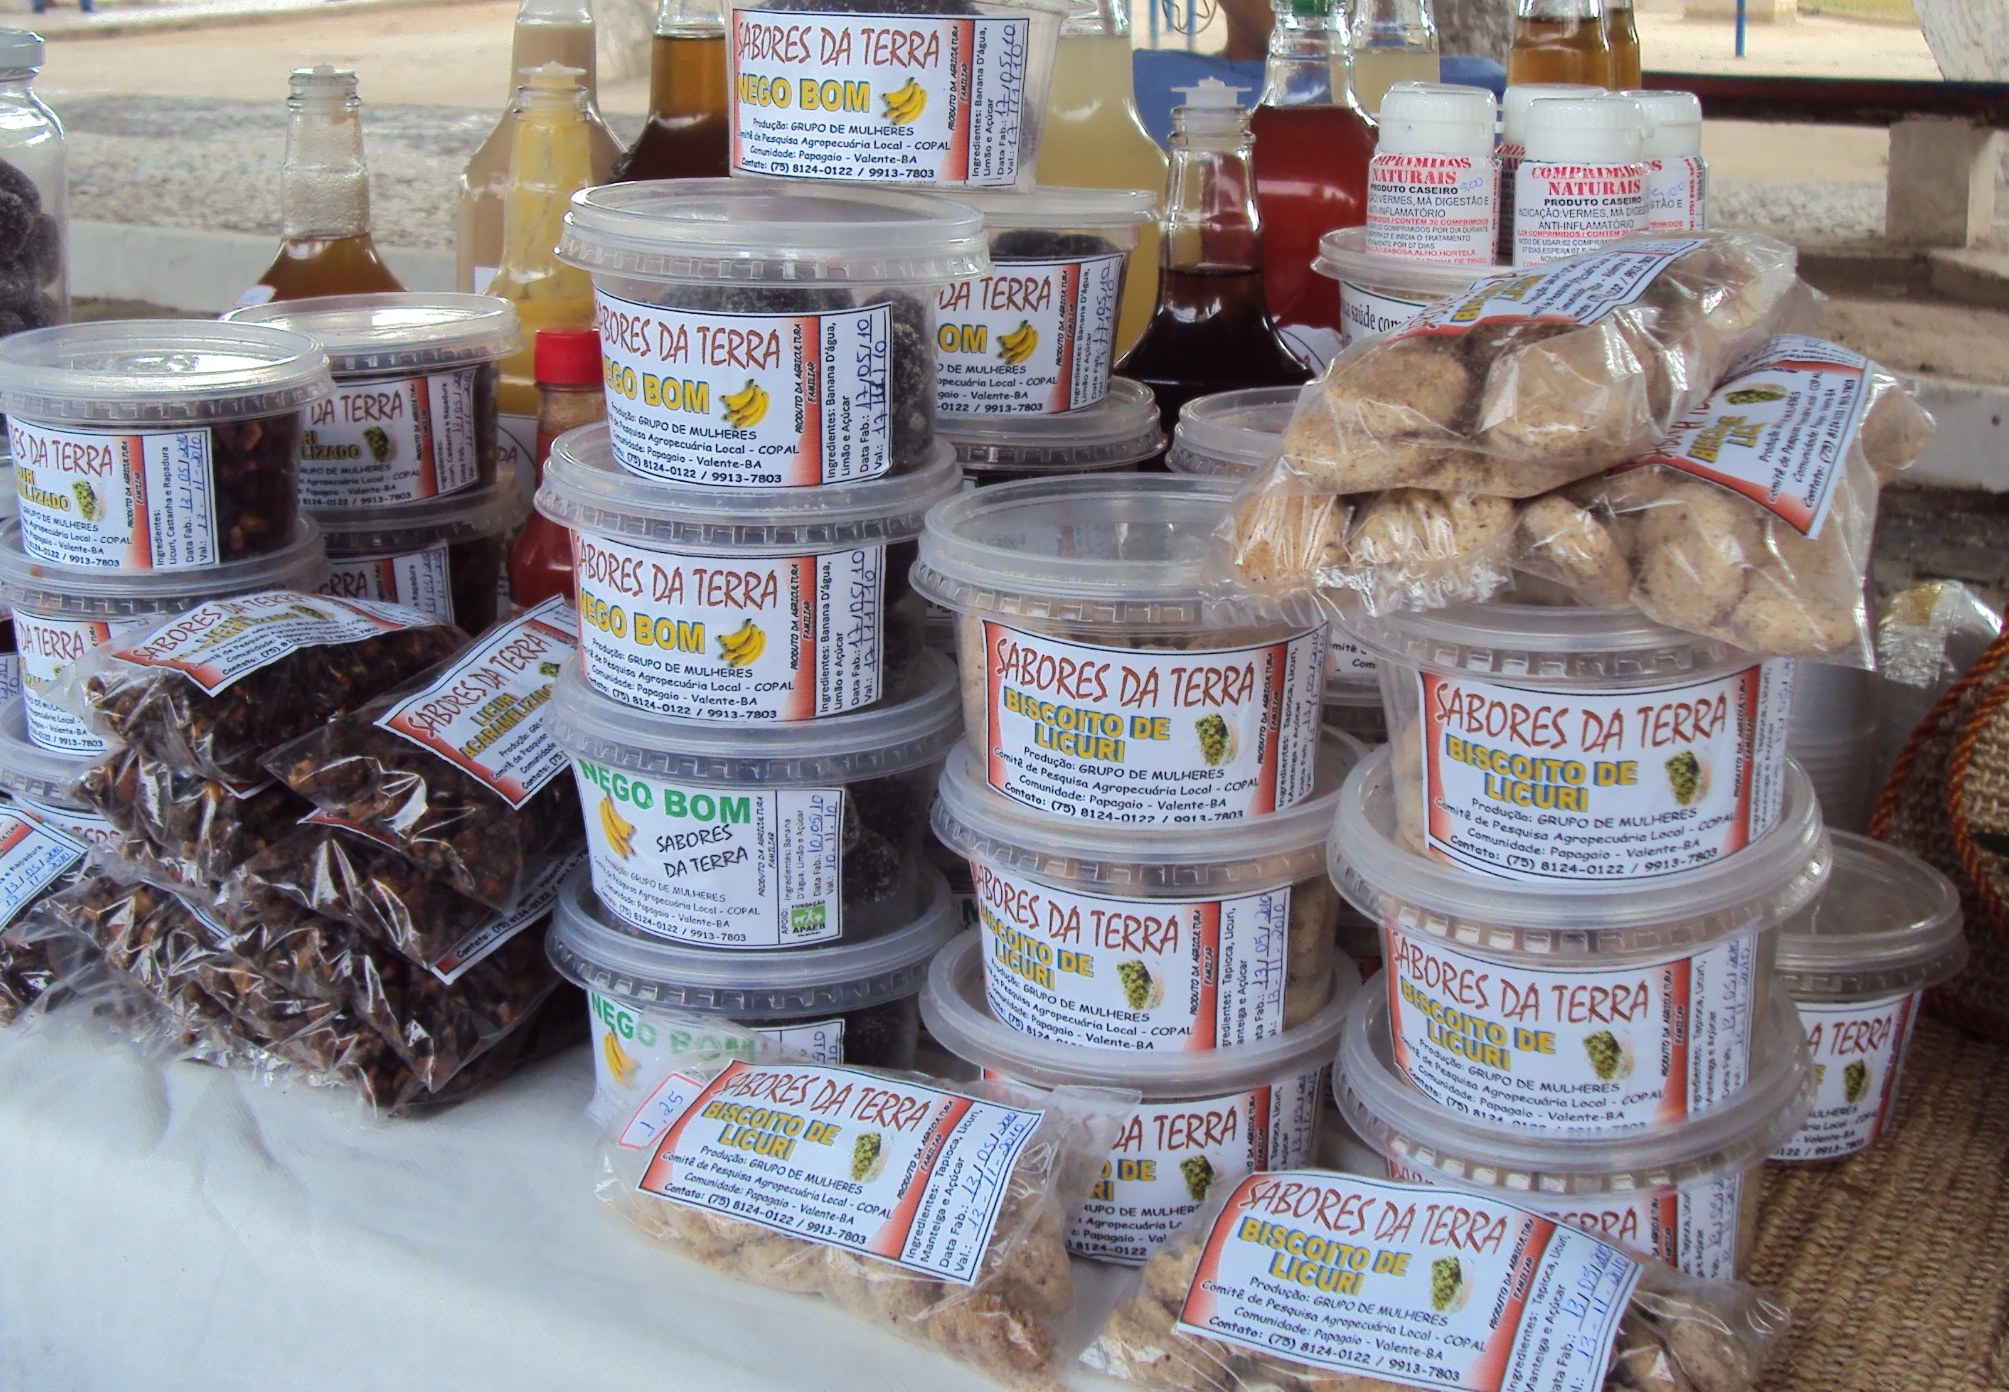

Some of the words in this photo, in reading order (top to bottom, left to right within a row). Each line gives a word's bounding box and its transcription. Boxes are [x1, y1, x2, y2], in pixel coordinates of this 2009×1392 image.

[738, 22, 812, 63] SABORES
[820, 27, 851, 66] DA
[861, 28, 940, 69] TERRA
[738, 72, 792, 108] NEGO
[799, 78, 870, 112] BOM
[975, 66, 984, 109] Banana
[752, 118, 788, 132] Produção:
[791, 122, 827, 134] GRUPO
[830, 124, 844, 134] DE
[848, 126, 914, 136] MULHERES
[972, 110, 982, 178] Ingredientes:
[1371, 184, 1405, 192] PRODUTO
[1372, 168, 1456, 184] NATURAIS
[1548, 180, 1640, 196] NATURAIS
[1544, 198, 1598, 206] PRODUTO
[1602, 197, 1641, 205] CASEIRO
[1539, 220, 1634, 230] ANTI-INFLAMATÓRIO
[980, 276, 1051, 312] TERRA
[598, 302, 650, 356] BORES
[658, 321, 688, 364] DA
[697, 326, 780, 370] TERRA
[1351, 303, 1375, 330] saúde
[795, 380, 802, 391] DA
[826, 368, 834, 410] Banana
[947, 365, 962, 373] DE
[965, 366, 1026, 374] MULHERES
[344, 390, 403, 422] TERRA
[643, 372, 709, 414] BOM
[794, 392, 804, 434] PRODUTO
[842, 396, 850, 433] Açúcar
[860, 416, 868, 444] Fab.:
[30, 435, 48, 468] DA
[52, 440, 113, 477] TERRA
[826, 412, 836, 479] Ingredientes:
[841, 445, 850, 476] Limão
[860, 450, 869, 472] Data
[163, 447, 171, 491] Rapadura
[167, 500, 175, 536] Castanha
[360, 492, 411, 504] 9913-7803
[152, 510, 164, 565] Ingredientes:
[169, 539, 177, 565] Licuri,
[580, 540, 643, 597] ABORES
[653, 563, 682, 604] DA
[693, 568, 777, 610] TERRA
[20, 622, 34, 652] DA
[34, 626, 84, 660] TERRA
[133, 609, 222, 661] SABORES
[221, 601, 244, 615] DA
[634, 612, 704, 654] BOM
[407, 680, 487, 738] SABORES
[468, 668, 510, 689] DA
[489, 632, 552, 674] TERRA
[996, 638, 1111, 703] SABORES
[1120, 666, 1158, 708] DA
[1170, 661, 1255, 707] TERRA
[470, 692, 520, 727] LICURI
[1003, 685, 1124, 739] BISCOITO
[1131, 715, 1170, 741] DE
[1436, 683, 1569, 750] SABORES
[1581, 708, 1623, 753] DA
[1637, 692, 1726, 750] TERRA
[1023, 746, 1076, 771] Produção:
[1078, 763, 1124, 779] GRUPO
[1129, 768, 1146, 779] DE
[1152, 770, 1225, 780] MULHERES
[1035, 722, 1125, 763] LICURI
[1446, 734, 1586, 786] BISCOITO
[1593, 761, 1638, 786] DE
[578, 759, 654, 810] NEGO
[664, 789, 751, 824] BOM
[994, 746, 1023, 767] Comitê
[1026, 763, 1038, 773] de
[1040, 766, 1089, 790] Pesquisa
[1092, 775, 1177, 797] Agropecuária
[1181, 784, 1212, 796] Local
[1224, 777, 1259, 791] COPAL
[1004, 782, 1046, 807] Contato:
[1051, 801, 1076, 816] (75)
[1080, 805, 1155, 822] 8124-0122
[1019, 775, 1085, 803] Comunidade:
[1089, 794, 1143, 810] Papagaio
[1157, 798, 1226, 810] Valente-BA
[1485, 773, 1589, 813] LICURI
[10, 845, 43, 871] Rapadura
[656, 824, 733, 853] SABORES
[1450, 836, 1501, 861] Contato:
[1506, 855, 1535, 870] (75)
[1541, 861, 1624, 874] 8124-0122
[1644, 848, 1717, 873] 9913-7803
[664, 860, 688, 878] DA
[693, 846, 749, 873] TERRA
[781, 908, 789, 934] APOIO:
[791, 900, 826, 909] FUNDAÇÃO
[977, 867, 1039, 929] ABORES
[1049, 900, 1081, 943] DA
[1090, 910, 1179, 955] TERRA
[792, 924, 826, 934] APAEB
[995, 938, 1055, 991] LICURI
[1057, 948, 1094, 977] DE
[1395, 937, 1489, 1010] SABORES
[1500, 979, 1539, 1022] DA
[1551, 981, 1648, 1024] TERRA
[591, 991, 657, 1047] NEGO
[1401, 975, 1506, 1046] BISCOITO
[1514, 1027, 1556, 1055] DE
[1427, 1019, 1510, 1072] LICURI
[1831, 1017, 1892, 1056] TERRA
[713, 1071, 812, 1106] SABORES
[812, 1080, 852, 1117] DA
[847, 1085, 932, 1132] TERRA
[702, 1100, 800, 1136] BISCOITO
[803, 1120, 842, 1147] DE
[717, 1125, 796, 1162] LICURI
[1153, 1105, 1236, 1151] TERRA
[905, 1181, 939, 1260] Ingredientes:
[935, 1136, 959, 1179] Tapioca,
[958, 1109, 984, 1136] Licuri,
[946, 1157, 966, 1194] Açúcar
[1118, 1159, 1156, 1181] DE
[664, 1183, 705, 1201] Contato:
[707, 1192, 730, 1209] (75)
[732, 1198, 794, 1227] 8124-0122
[807, 1221, 867, 1245] 9913-7803
[942, 1197, 952, 1208] e
[1239, 1180, 1376, 1236] SABORES
[1374, 1202, 1420, 1244] DA
[1420, 1205, 1508, 1255] TERRA
[922, 1209, 946, 1263] Manteiga
[940, 1237, 958, 1268] Data
[953, 1205, 970, 1240] Fab.:
[1239, 1216, 1373, 1271] BISCOITO
[1374, 1251, 1412, 1277] DE
[1269, 1252, 1365, 1297] LICURI
[1249, 1276, 1310, 1304] Produção:
[1314, 1296, 1355, 1314] GRUPO
[1358, 1303, 1376, 1316] DE
[1379, 1305, 1448, 1327] MULHERES
